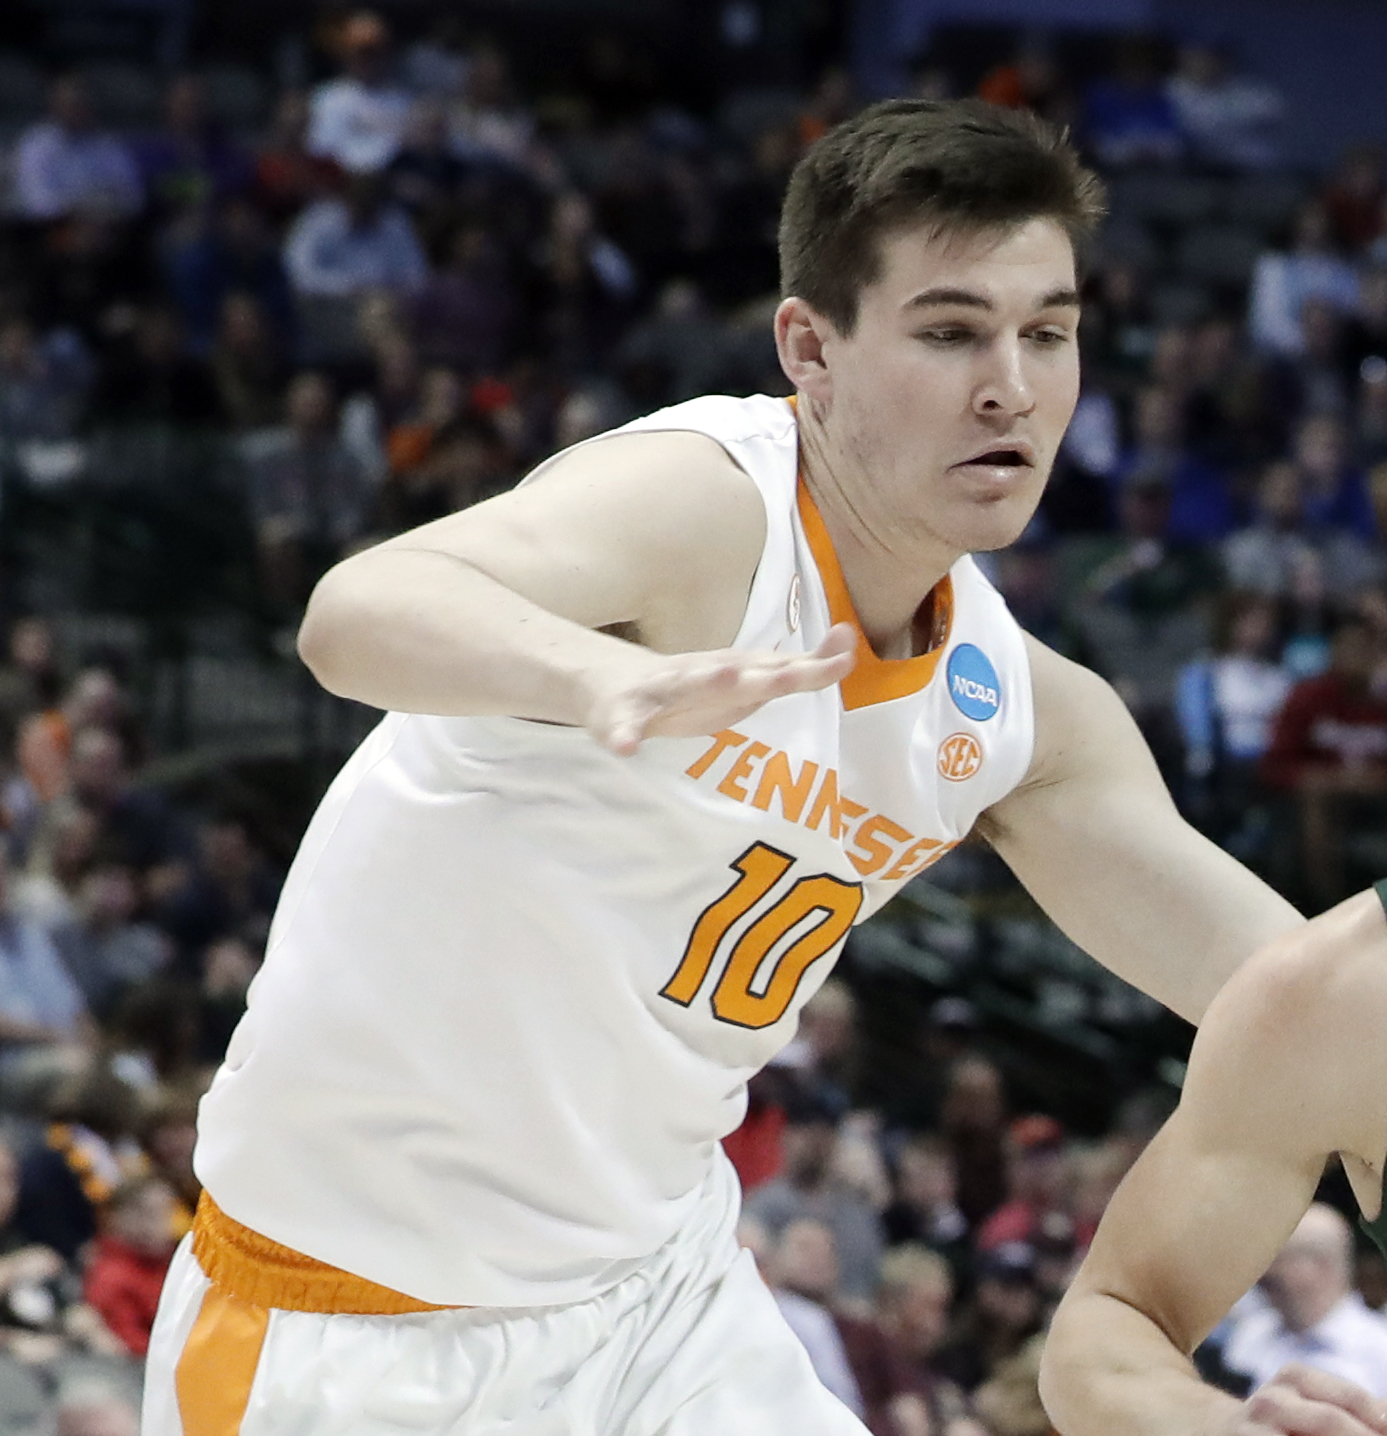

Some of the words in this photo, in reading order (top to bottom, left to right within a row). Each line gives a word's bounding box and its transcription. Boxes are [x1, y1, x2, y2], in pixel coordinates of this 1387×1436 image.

[952, 674, 998, 708] NCAA
[940, 737, 980, 777] SEC
[658, 840, 864, 1030] 10
